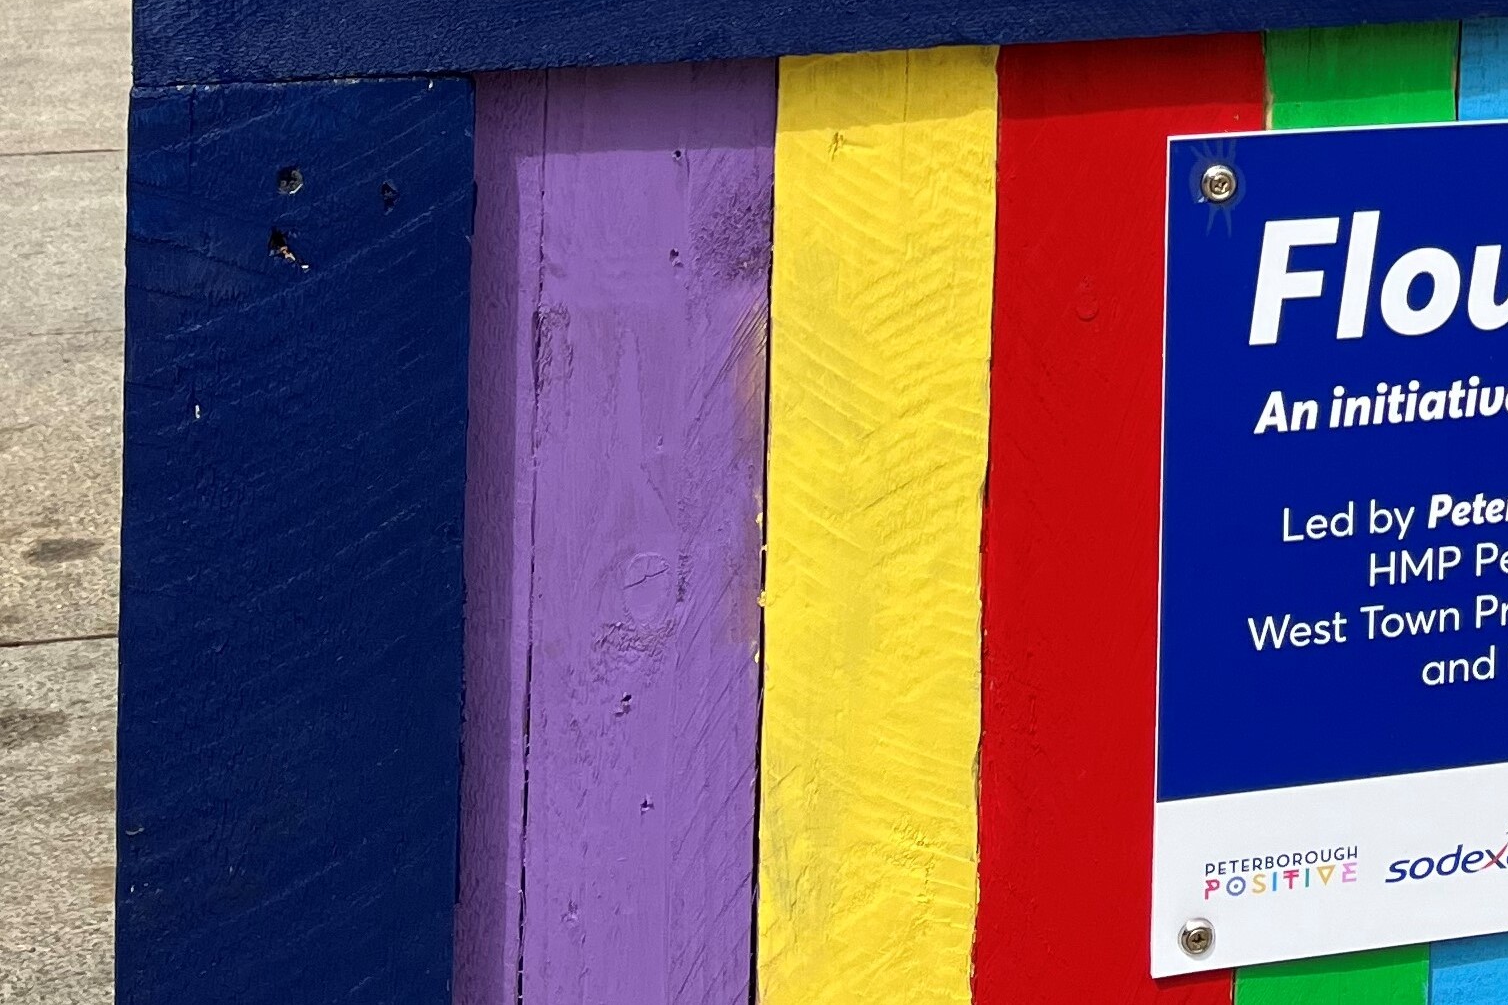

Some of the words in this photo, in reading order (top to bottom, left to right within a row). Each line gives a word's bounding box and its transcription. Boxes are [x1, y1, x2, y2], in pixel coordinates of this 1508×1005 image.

[1254, 391, 1318, 434] An
[1284, 501, 1353, 541] Led
[1370, 499, 1414, 540] by
[1370, 546, 1461, 586] HMP
[1248, 612, 1347, 650] West
[1360, 605, 1459, 639] Town
[1422, 645, 1495, 685] and
[1204, 862, 1358, 900] POSITIVE
[1205, 846, 1358, 877] PETERBOROUGH
